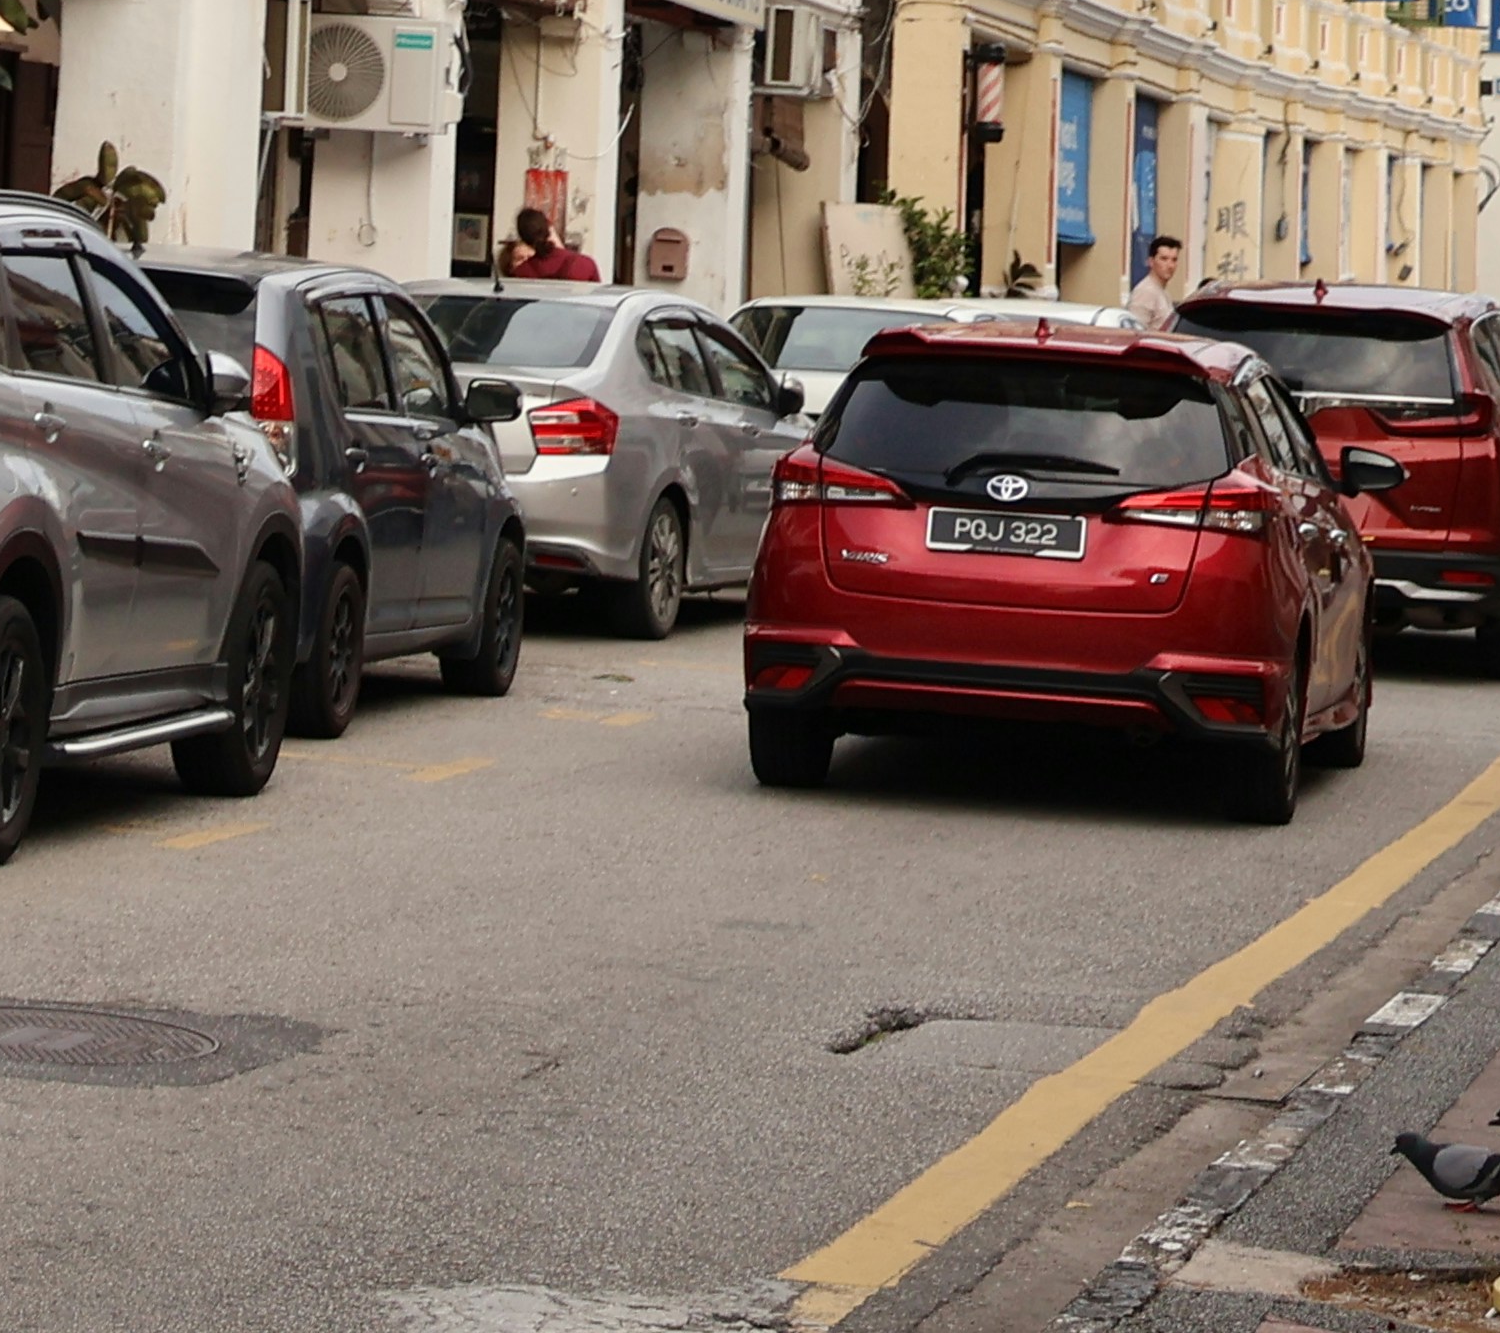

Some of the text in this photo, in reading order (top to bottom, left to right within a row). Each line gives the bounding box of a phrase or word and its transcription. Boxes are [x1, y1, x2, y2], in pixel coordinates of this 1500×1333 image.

[954, 517, 1058, 546] PQJ 322
[842, 549, 889, 564] YARIS
